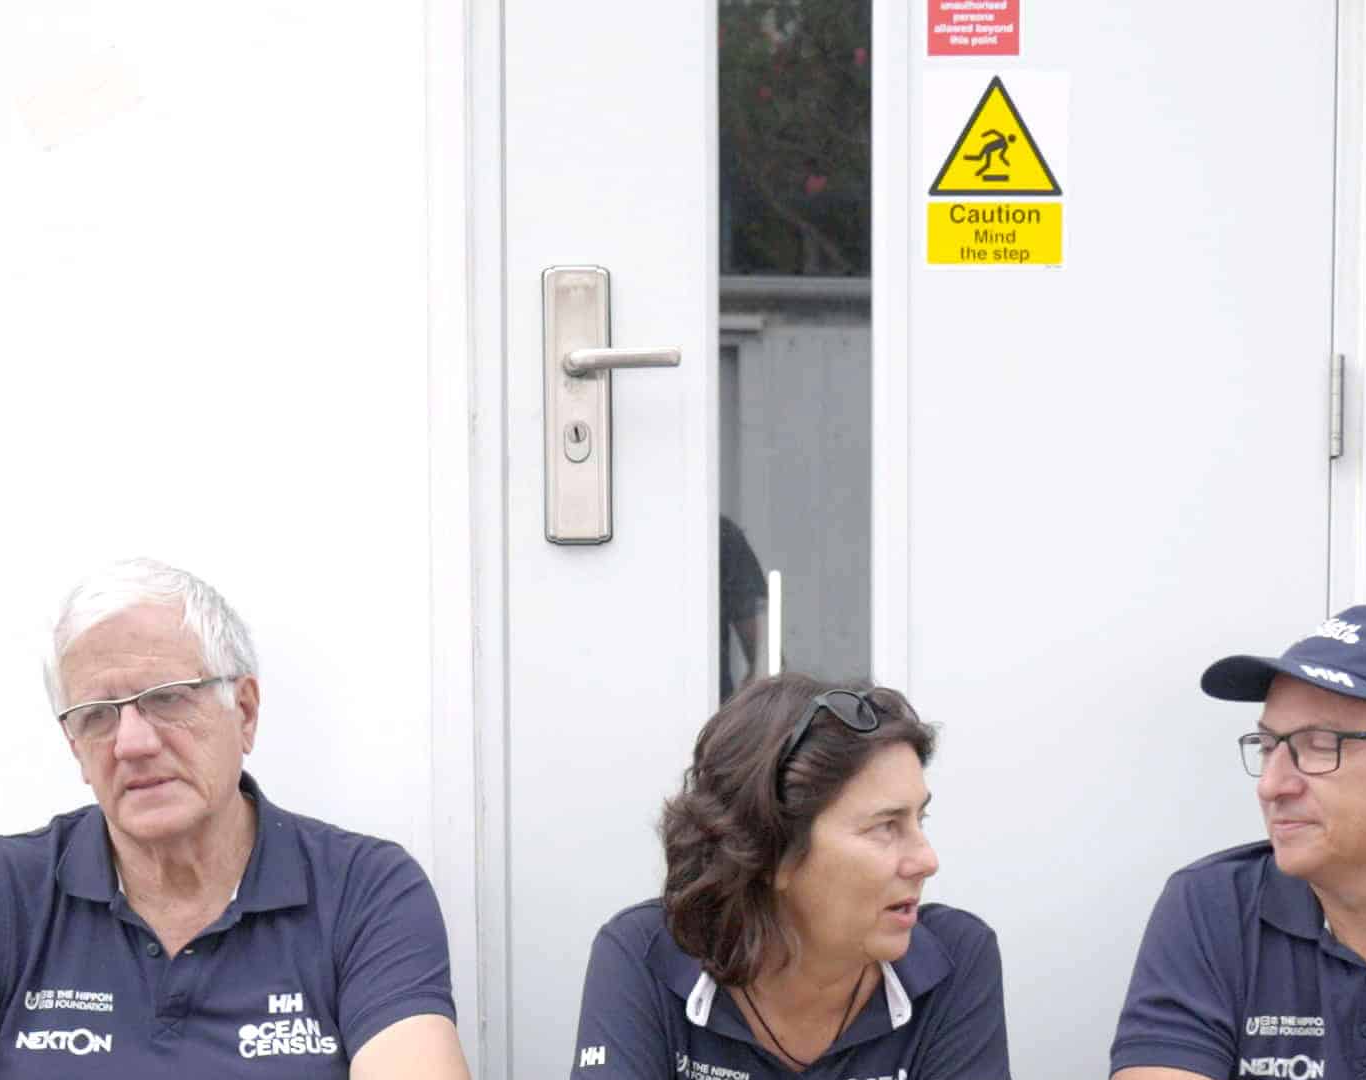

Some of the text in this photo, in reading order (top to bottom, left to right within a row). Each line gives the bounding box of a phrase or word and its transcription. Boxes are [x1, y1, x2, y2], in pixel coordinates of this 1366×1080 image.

[952, 14, 995, 23] persons
[934, 24, 1014, 35] allowed beyond
[949, 35, 999, 47] this point
[949, 204, 1041, 224] Caution
[973, 229, 1017, 243] Mind
[960, 247, 1030, 264] the step
[55, 999, 114, 1012] FOUNDATION
[267, 992, 304, 1014] HH
[238, 1018, 322, 1041] OCEAN
[15, 1027, 113, 1056] NEKTON
[238, 1035, 338, 1058] CENSUS
